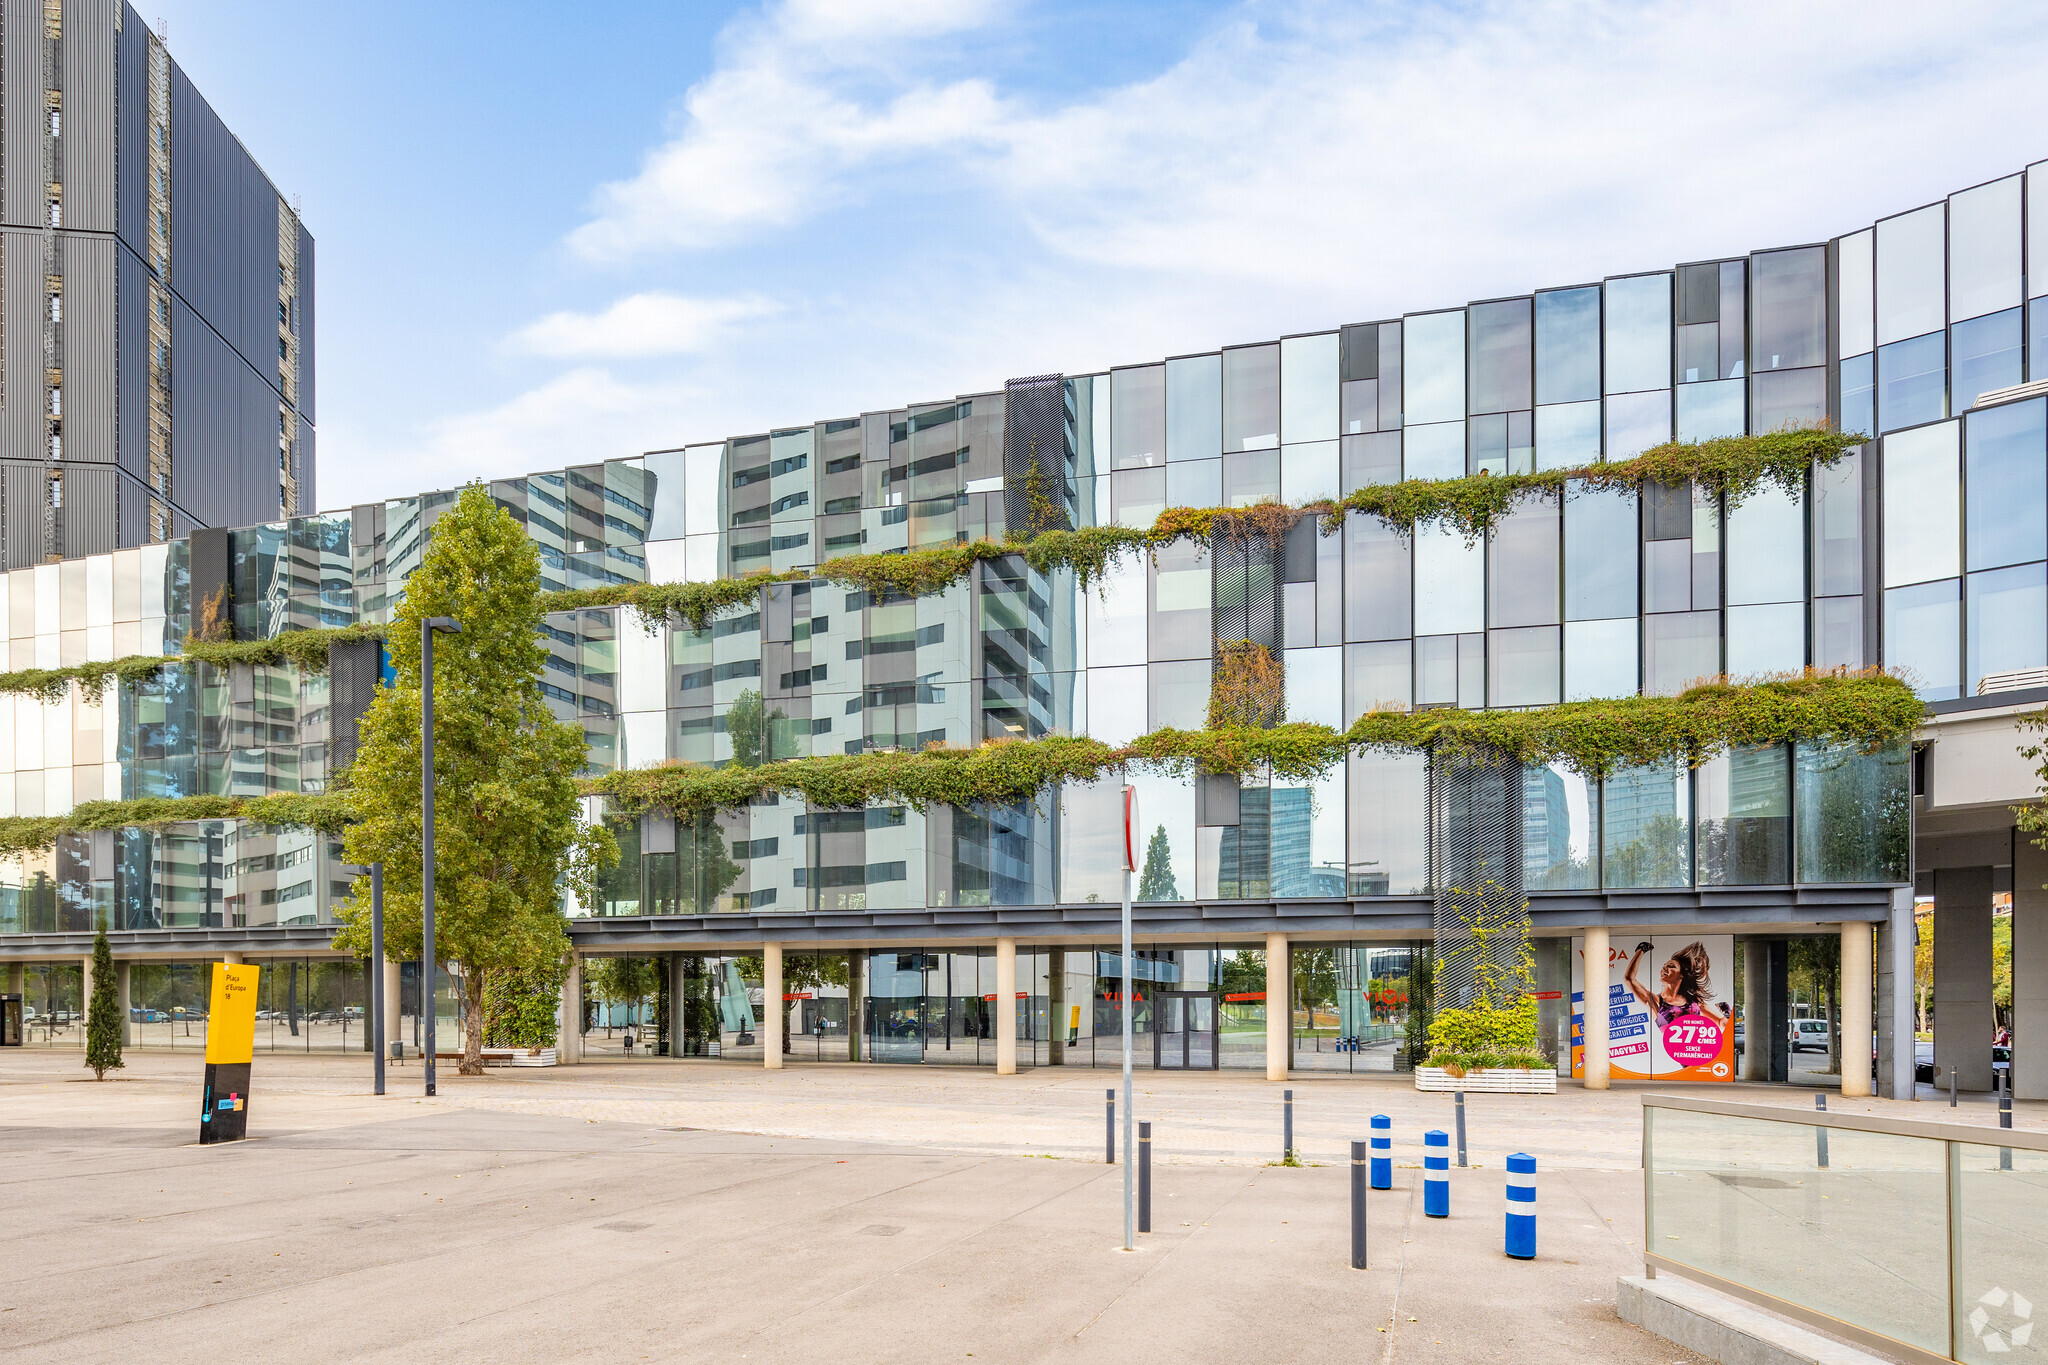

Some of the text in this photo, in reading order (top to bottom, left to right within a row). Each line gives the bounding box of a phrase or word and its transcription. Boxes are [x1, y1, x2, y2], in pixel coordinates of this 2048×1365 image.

[226, 974, 240, 982] Plaça
[225, 984, 247, 992] d'Europa
[1617, 1015, 1646, 1027] DIRIGIDES
